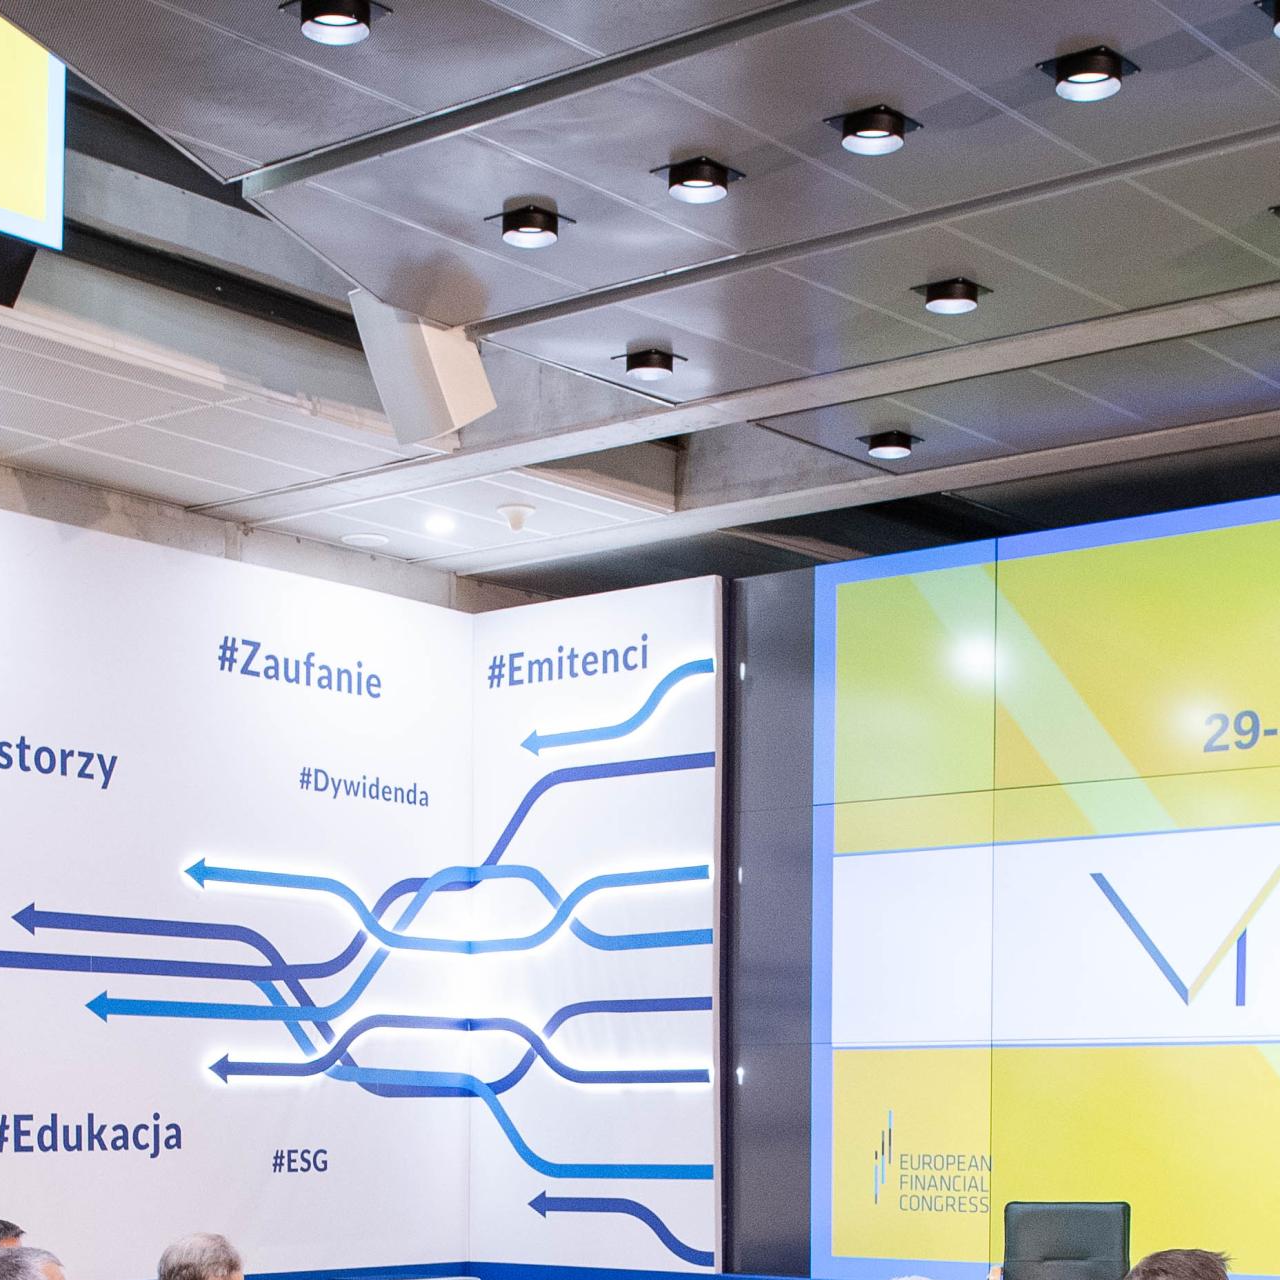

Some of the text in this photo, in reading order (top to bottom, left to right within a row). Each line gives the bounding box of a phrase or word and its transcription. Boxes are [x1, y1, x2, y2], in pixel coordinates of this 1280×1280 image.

[218, 635, 382, 699] #Zaufanie
[487, 633, 648, 689] #Emitenci
[299, 766, 429, 807] #Dywidenda
[272, 1148, 328, 1173] #ESG
[899, 1153, 992, 1172] EUROPEAN
[899, 1174, 989, 1192] FINANCIAL
[899, 1194, 990, 1214] CONGRESS
